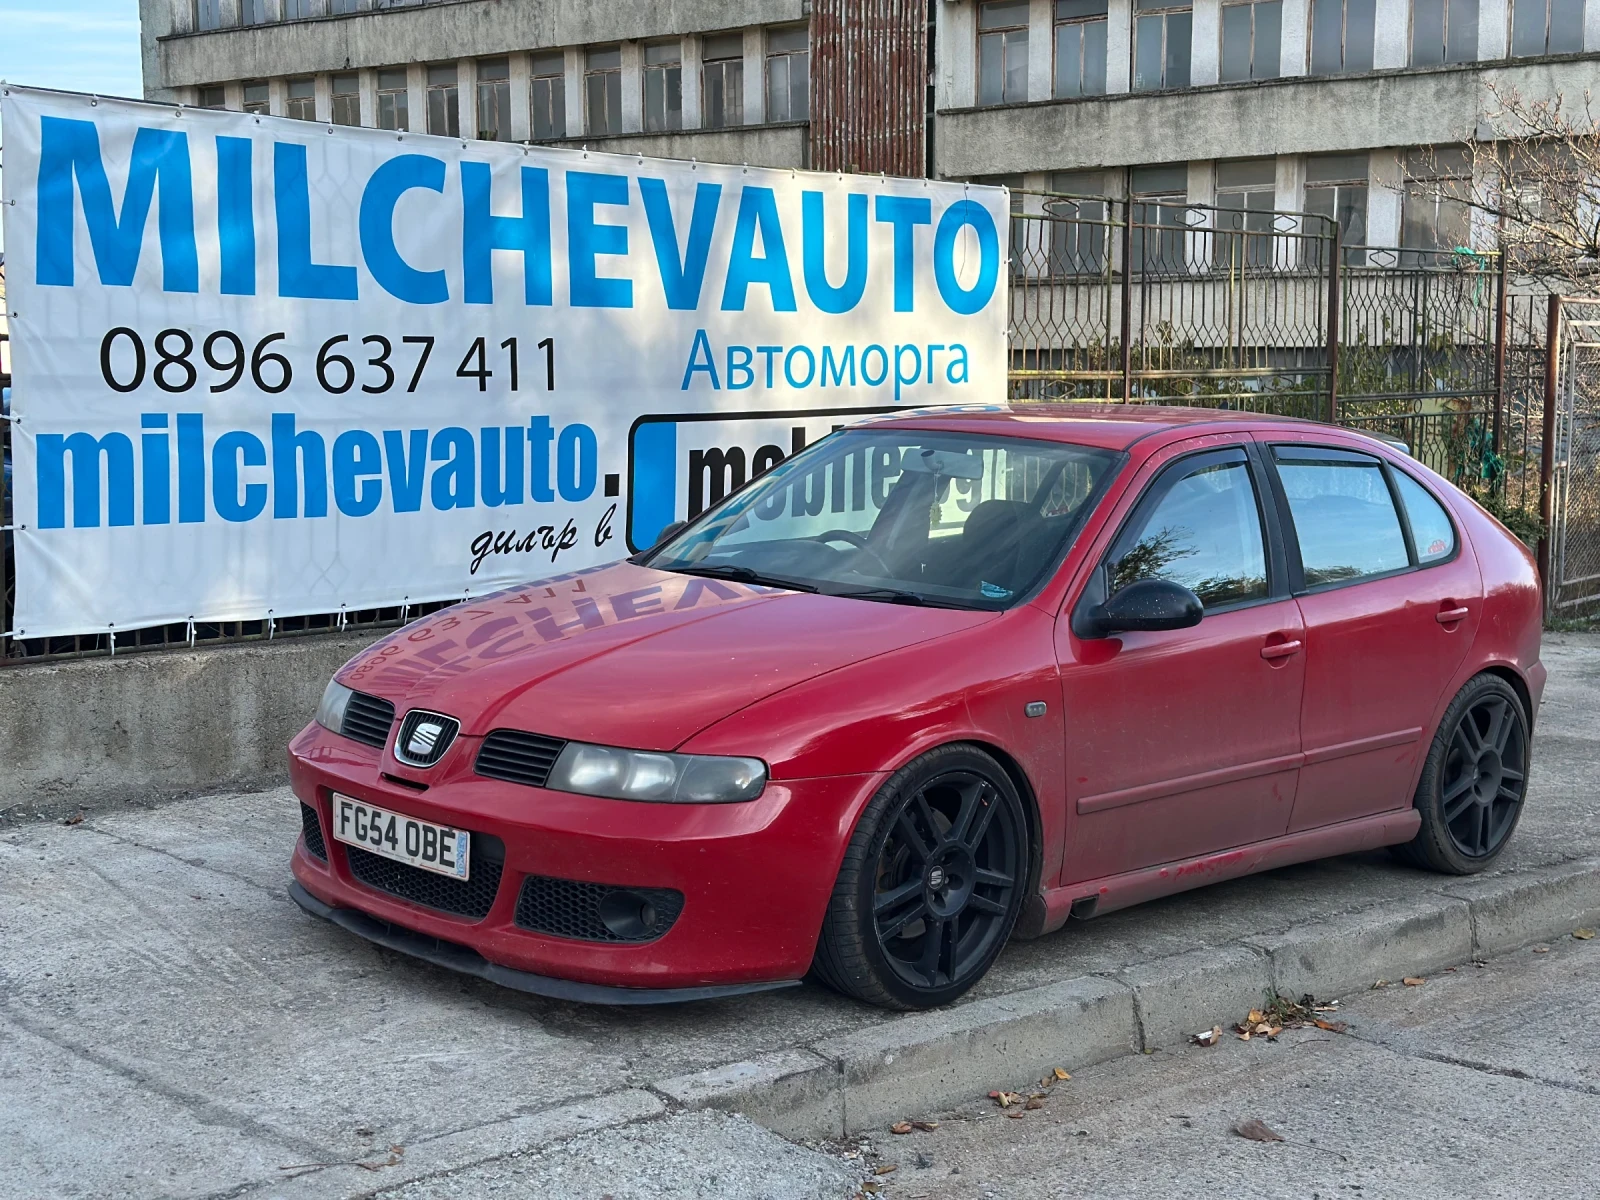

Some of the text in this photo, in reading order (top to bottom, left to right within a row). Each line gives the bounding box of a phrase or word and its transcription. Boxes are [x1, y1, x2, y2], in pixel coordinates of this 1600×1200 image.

[36, 115, 999, 315] MILCHEVAUTO
[100, 326, 556, 395] 0896 637 411
[682, 329, 970, 401] Автоморга
[470, 502, 617, 576] дилър в
[340, 800, 399, 851] FG54
[405, 820, 456, 869] OBE
